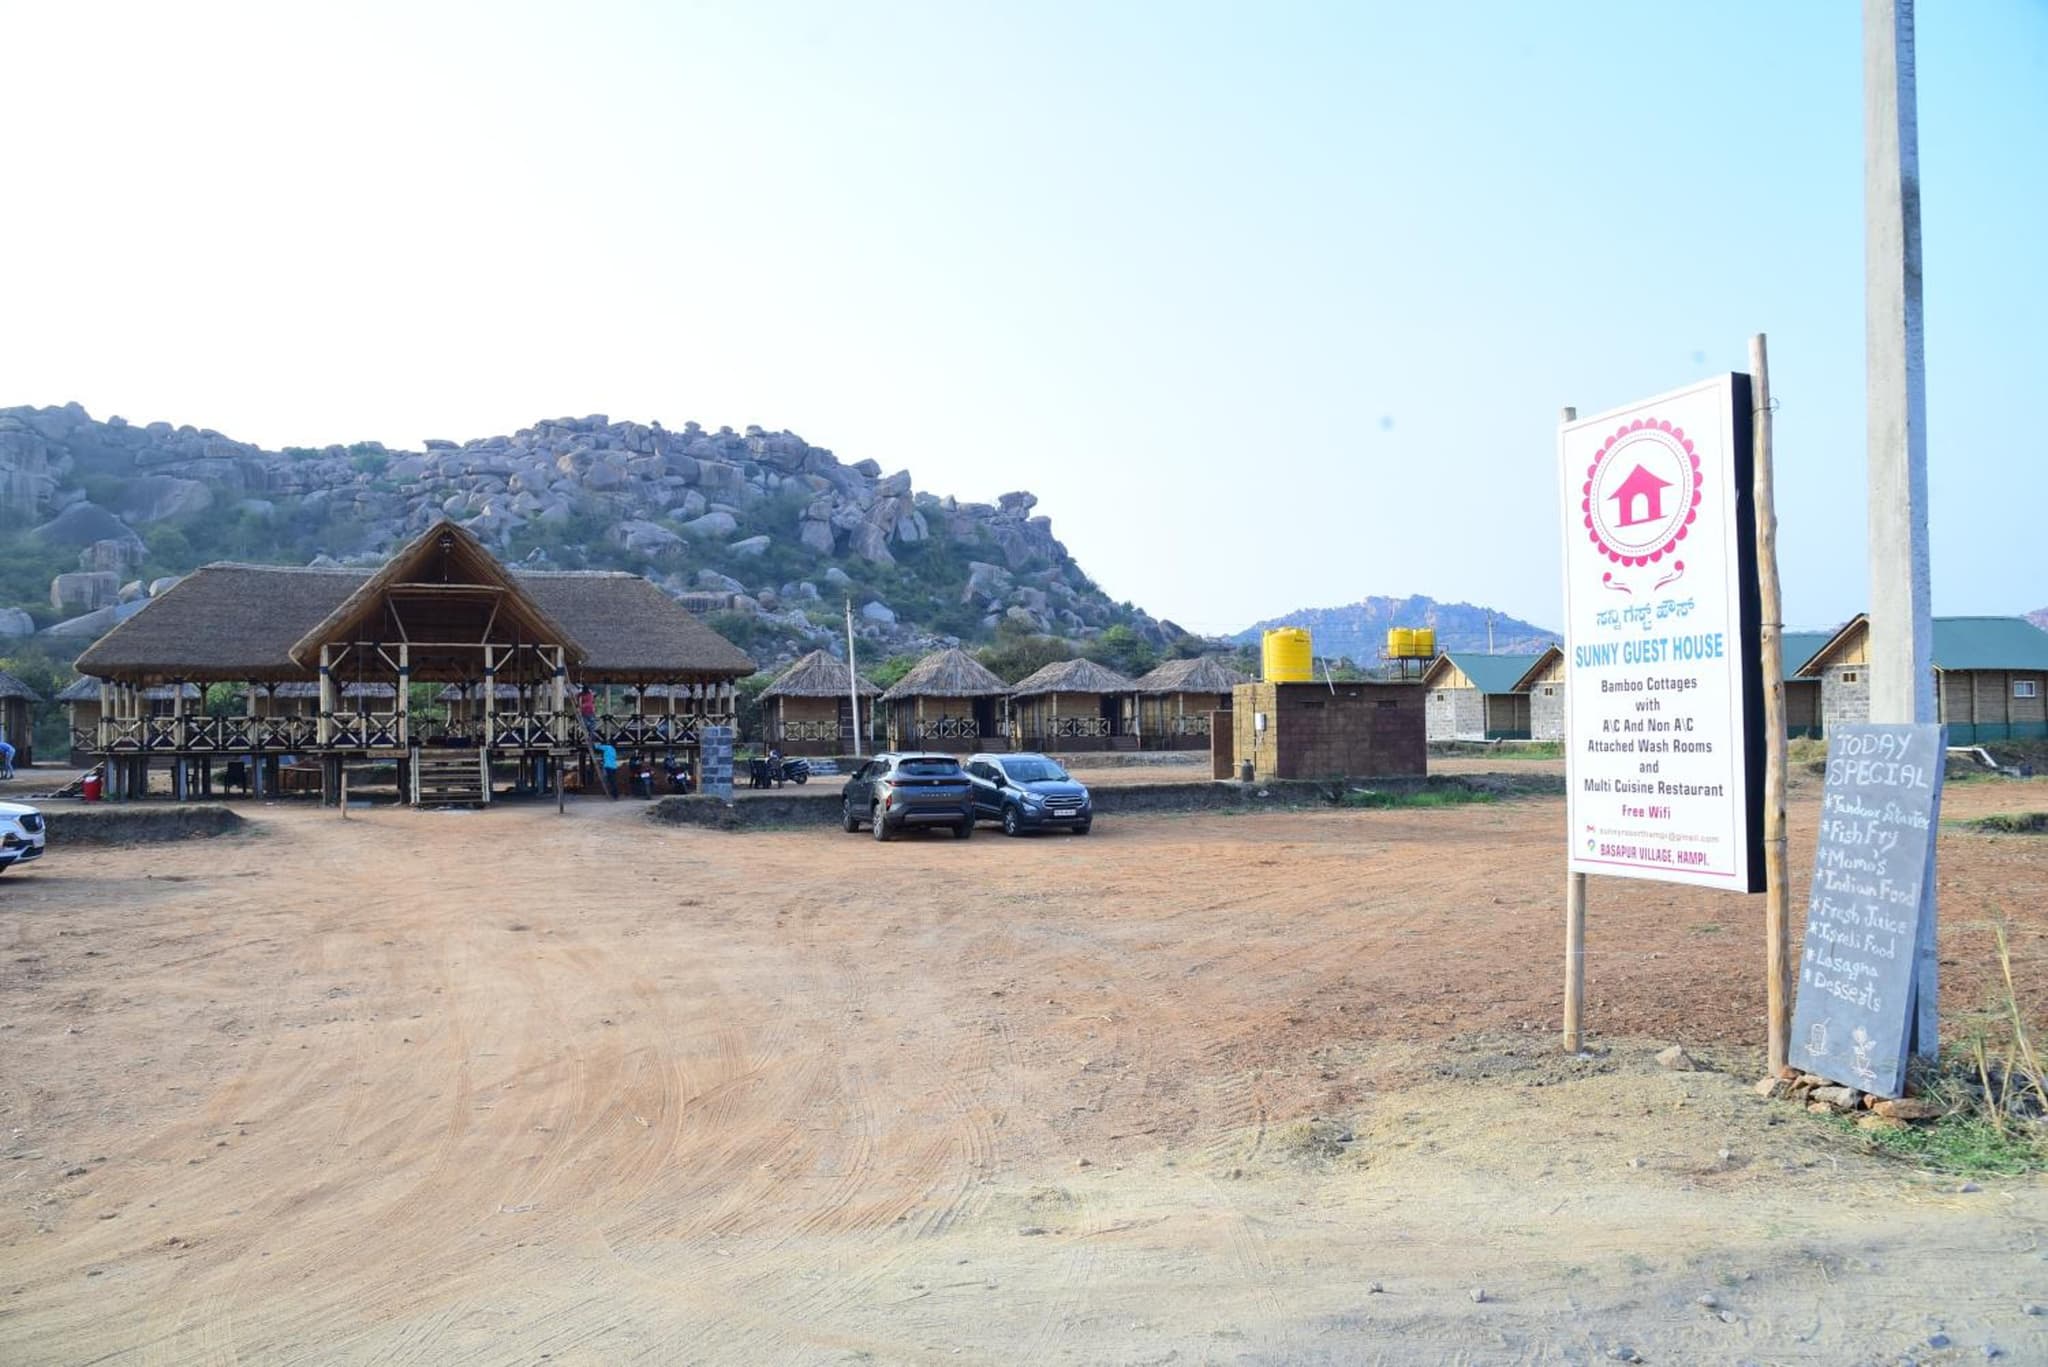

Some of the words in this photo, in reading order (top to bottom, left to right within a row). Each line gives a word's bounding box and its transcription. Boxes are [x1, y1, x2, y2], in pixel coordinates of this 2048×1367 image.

[1575, 642, 1618, 668] SUNNY
[1623, 638, 1668, 664] GUEST
[1673, 632, 1723, 661] HOUSE
[1601, 679, 1643, 693] Bamboo
[1647, 676, 1698, 692] Cottages
[1635, 697, 1661, 712] with
[1624, 718, 1644, 732] And
[1647, 717, 1670, 732] Non
[1588, 739, 1635, 753] Attached
[1638, 739, 1669, 753] Wash
[1673, 739, 1713, 753] Rooms
[1837, 733, 1912, 760] TODAY
[1639, 760, 1660, 774] and
[1826, 759, 1929, 790] SPECIAL
[1584, 778, 1612, 793] Multi
[1614, 779, 1654, 795] Cuisine
[1658, 781, 1724, 797] Restaurant
[1622, 804, 1645, 818] Free
[1648, 805, 1671, 820] Wifi
[1830, 820, 1863, 844] Fish
[1864, 820, 1899, 853] Fry
[1600, 844, 1637, 860] BASAPUR
[1639, 847, 1675, 864] VILLAGE,
[1824, 869, 1877, 897] Indian
[1880, 879, 1917, 907] Food
[1820, 896, 1860, 925] Fresh
[1863, 934, 1896, 959] Food
[1816, 947, 1879, 981] Lasagna
